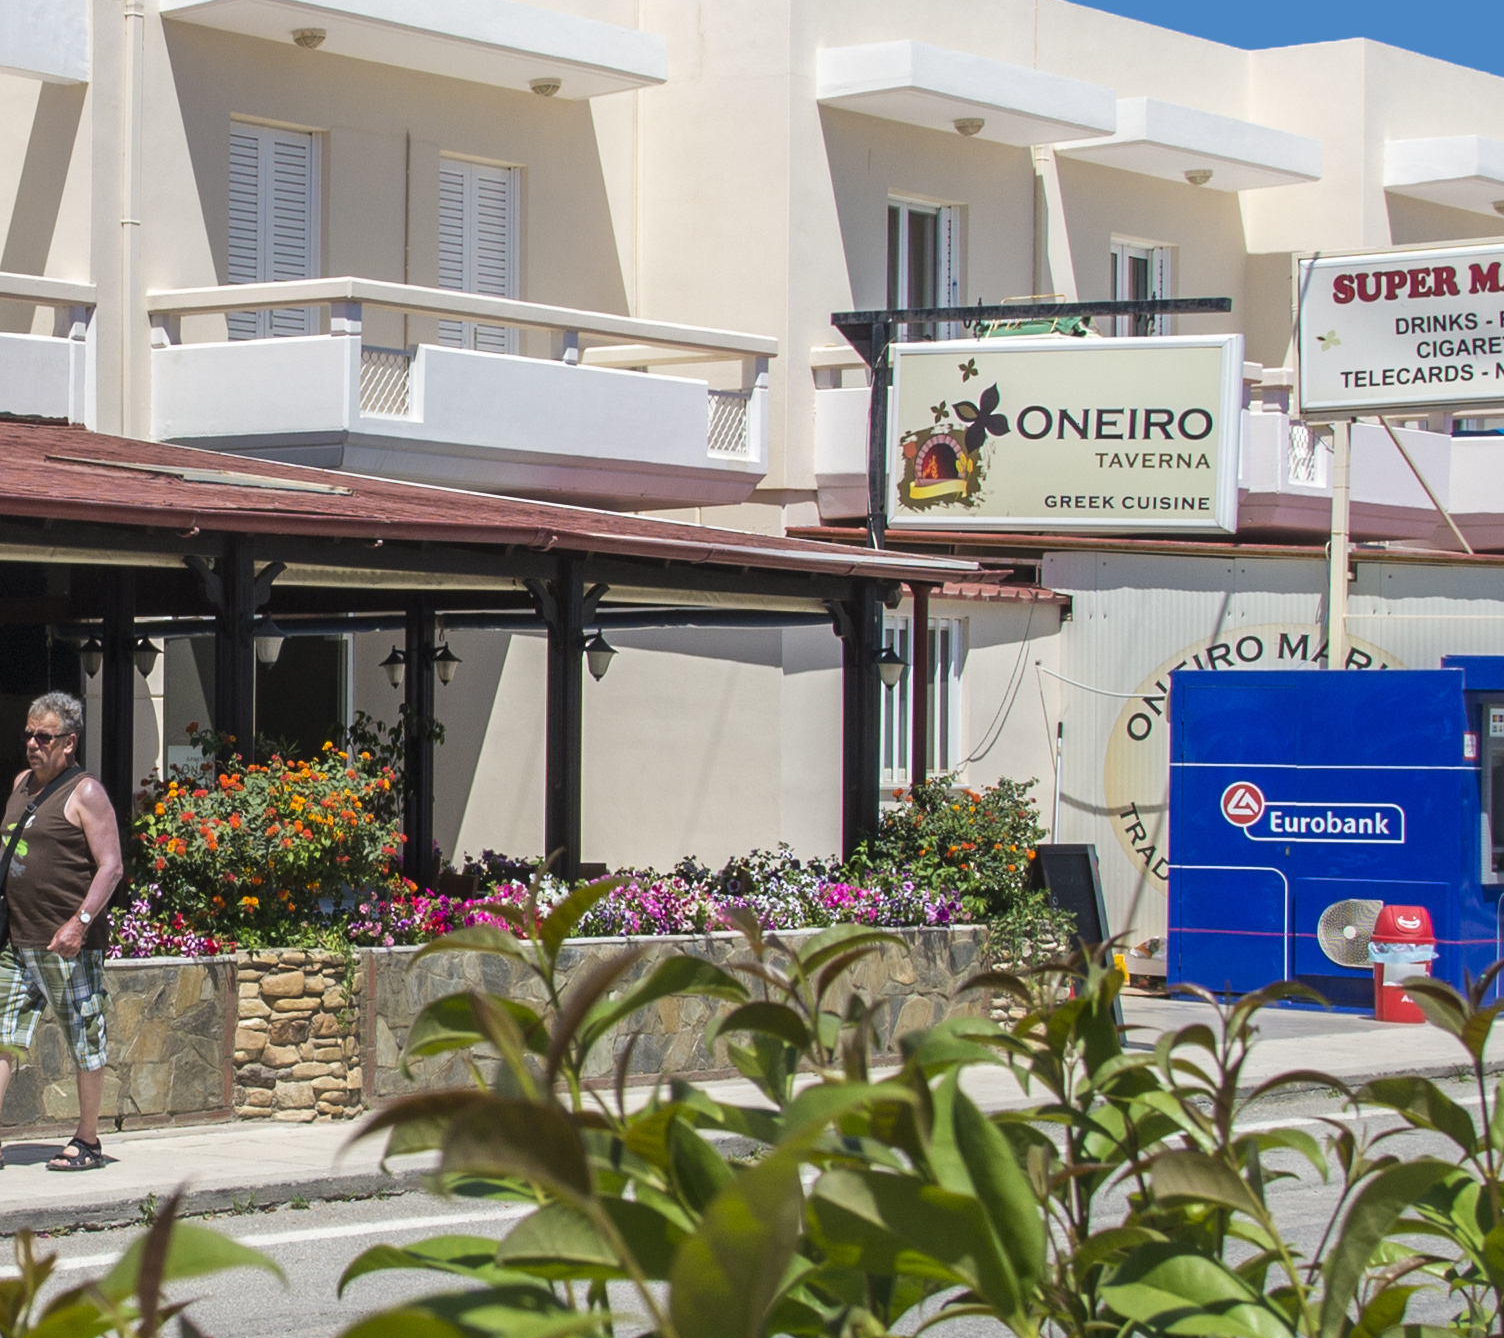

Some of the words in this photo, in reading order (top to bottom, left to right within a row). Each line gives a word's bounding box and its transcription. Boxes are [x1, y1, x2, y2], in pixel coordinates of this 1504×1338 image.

[1333, 267, 1460, 305] SUPER
[1395, 312, 1478, 335] DRINKS
[1340, 364, 1474, 389] TELECARDS
[1016, 405, 1214, 441] ONEIRO
[1095, 452, 1211, 469] TAVERNA
[1044, 495, 1115, 510] GREEK
[1122, 495, 1211, 511] CUISINE
[1269, 810, 1391, 835] Eurobank
